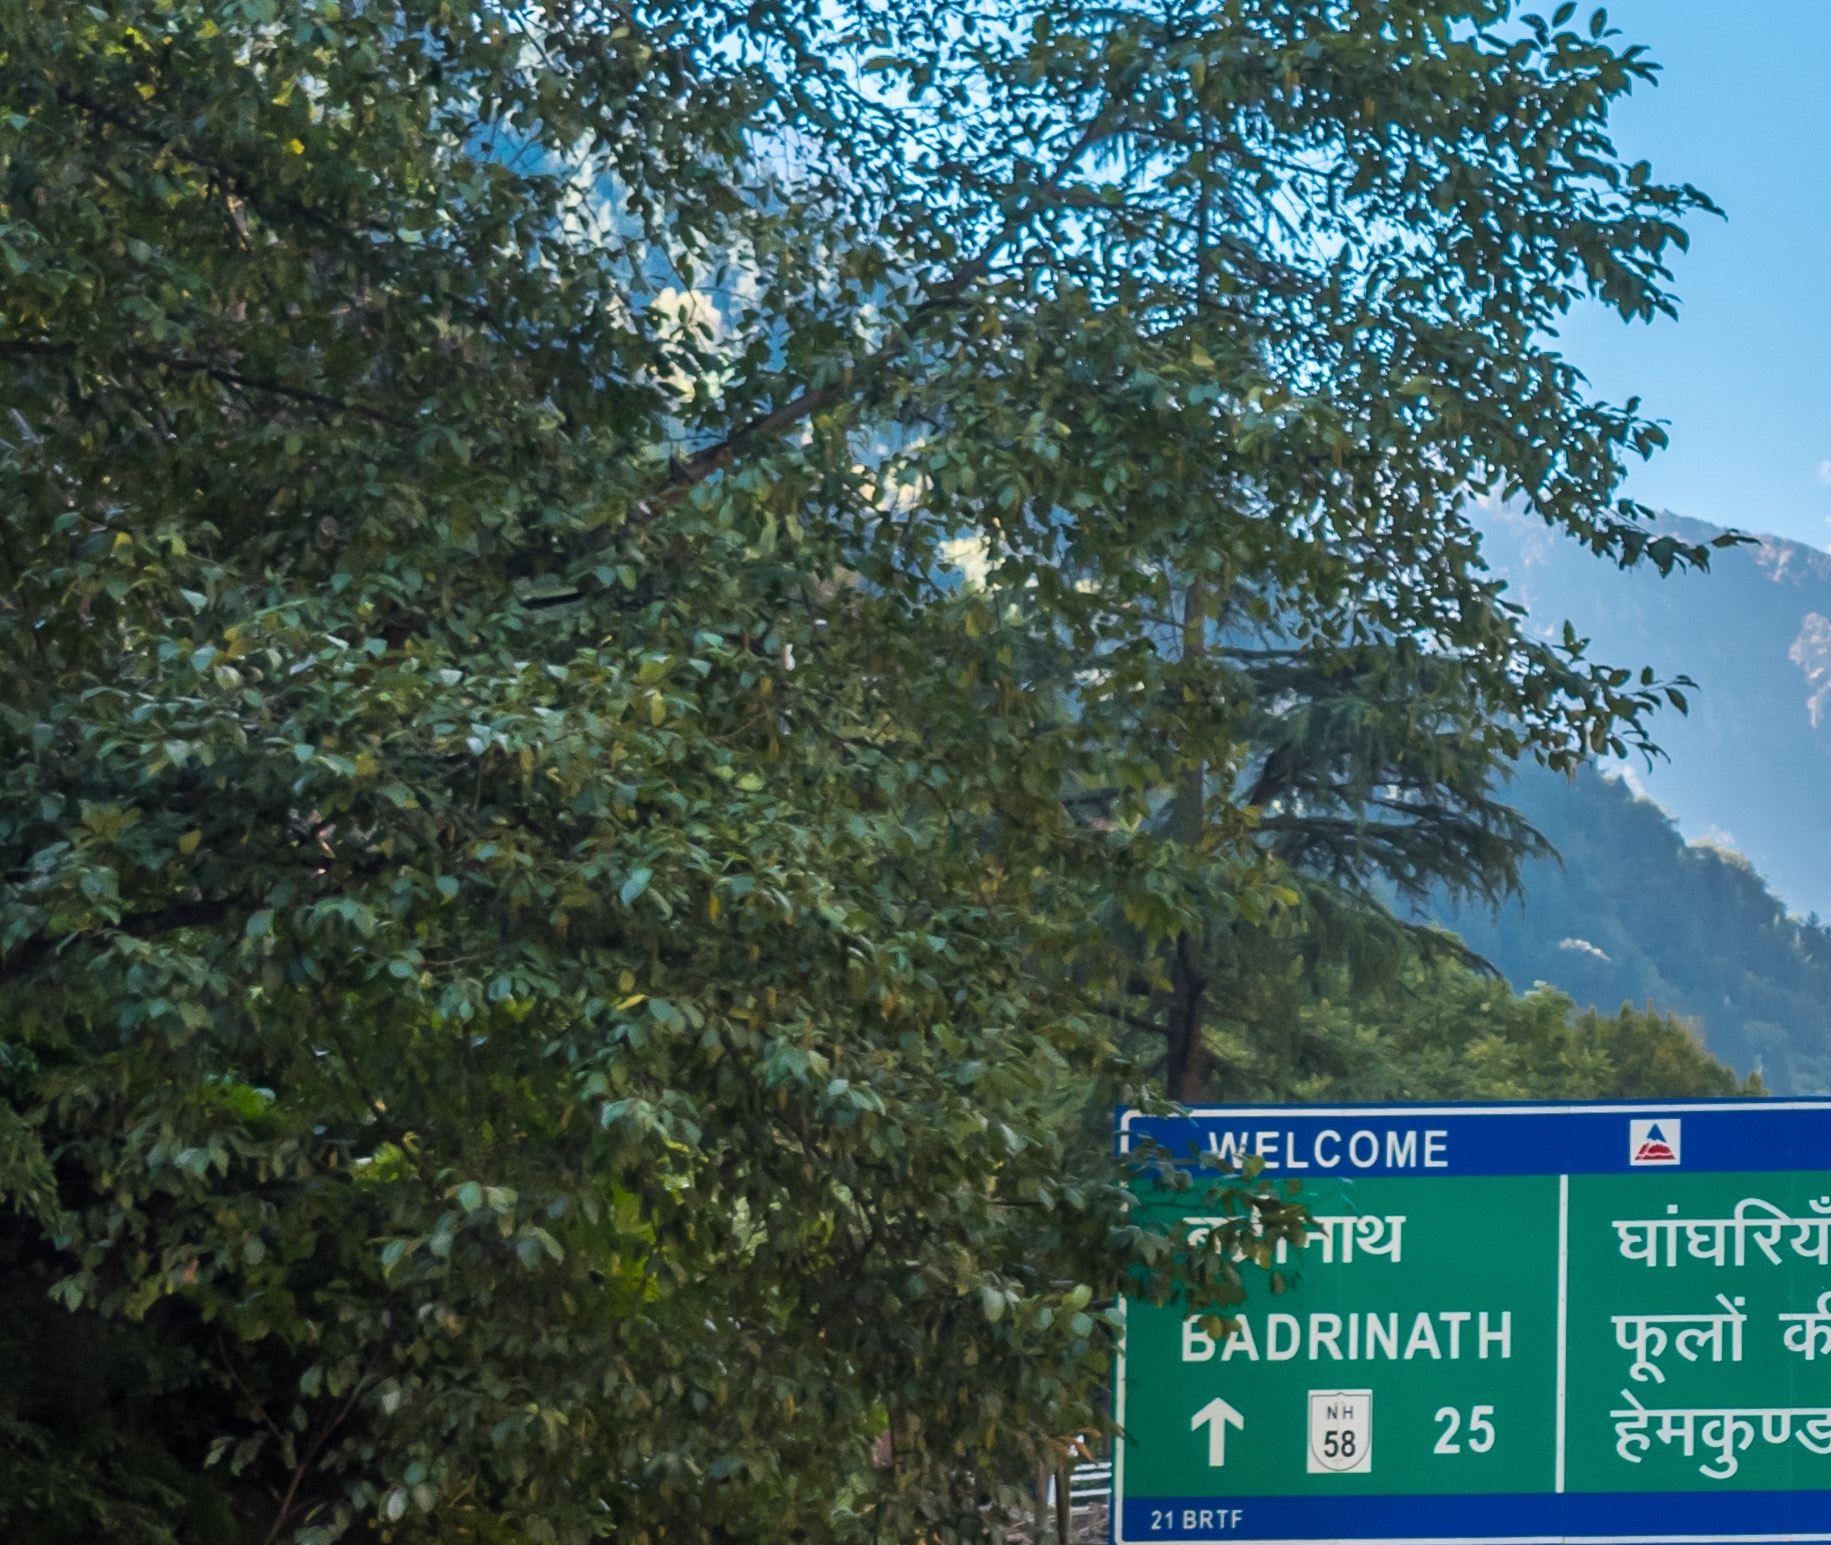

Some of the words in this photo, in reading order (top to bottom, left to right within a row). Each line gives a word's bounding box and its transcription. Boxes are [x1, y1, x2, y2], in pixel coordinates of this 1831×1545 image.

[1209, 1129, 1448, 1169] WELCOME
[1182, 1311, 1511, 1362] BADRINATH
[1610, 1293, 1748, 1384] फूलों
[1326, 1404, 1355, 1420] NH
[1433, 1405, 1495, 1454] 25
[1323, 1429, 1357, 1459] 58
[1151, 1510, 1173, 1530] 21
[1182, 1509, 1243, 1530] BRTF
